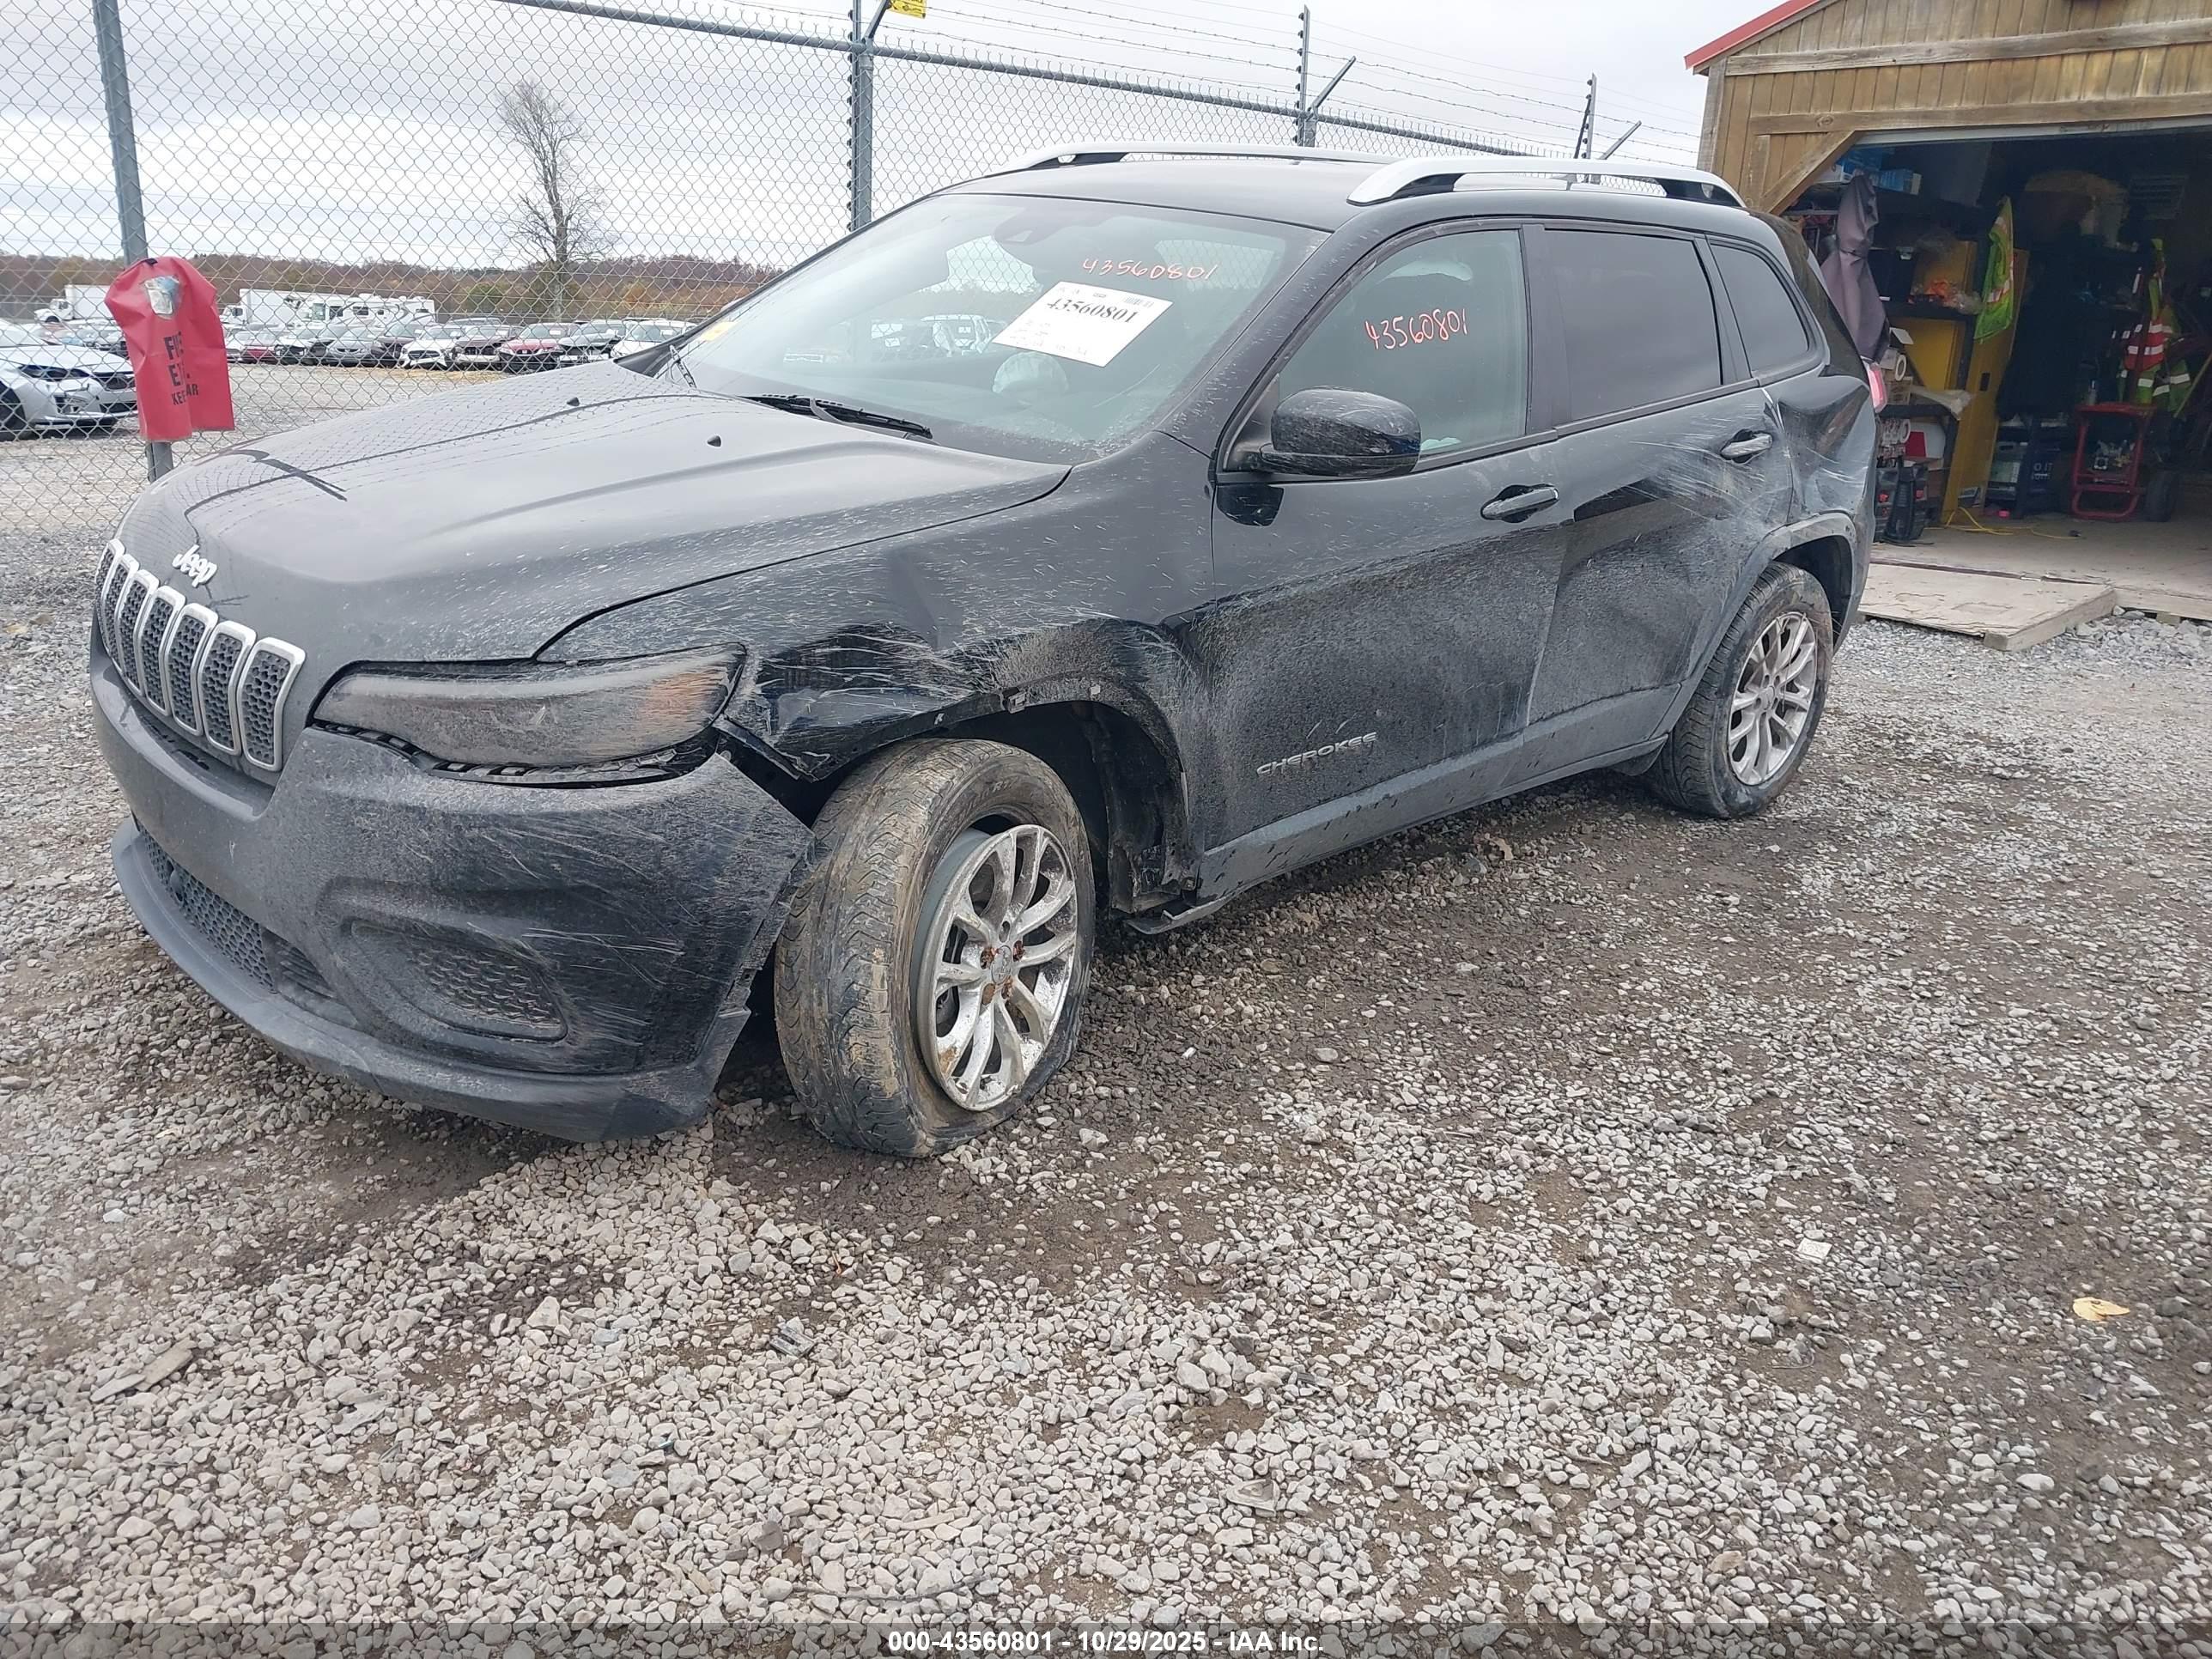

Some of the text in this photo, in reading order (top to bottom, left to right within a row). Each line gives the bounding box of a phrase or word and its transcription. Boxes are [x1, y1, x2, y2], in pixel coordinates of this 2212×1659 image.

[1081, 258, 1219, 280] 43560801
[1046, 297, 1139, 325] 43560801
[1364, 308, 1468, 349] 43560801
[172, 544, 217, 588] Jeep
[1256, 732, 1377, 775] CHEROKEE
